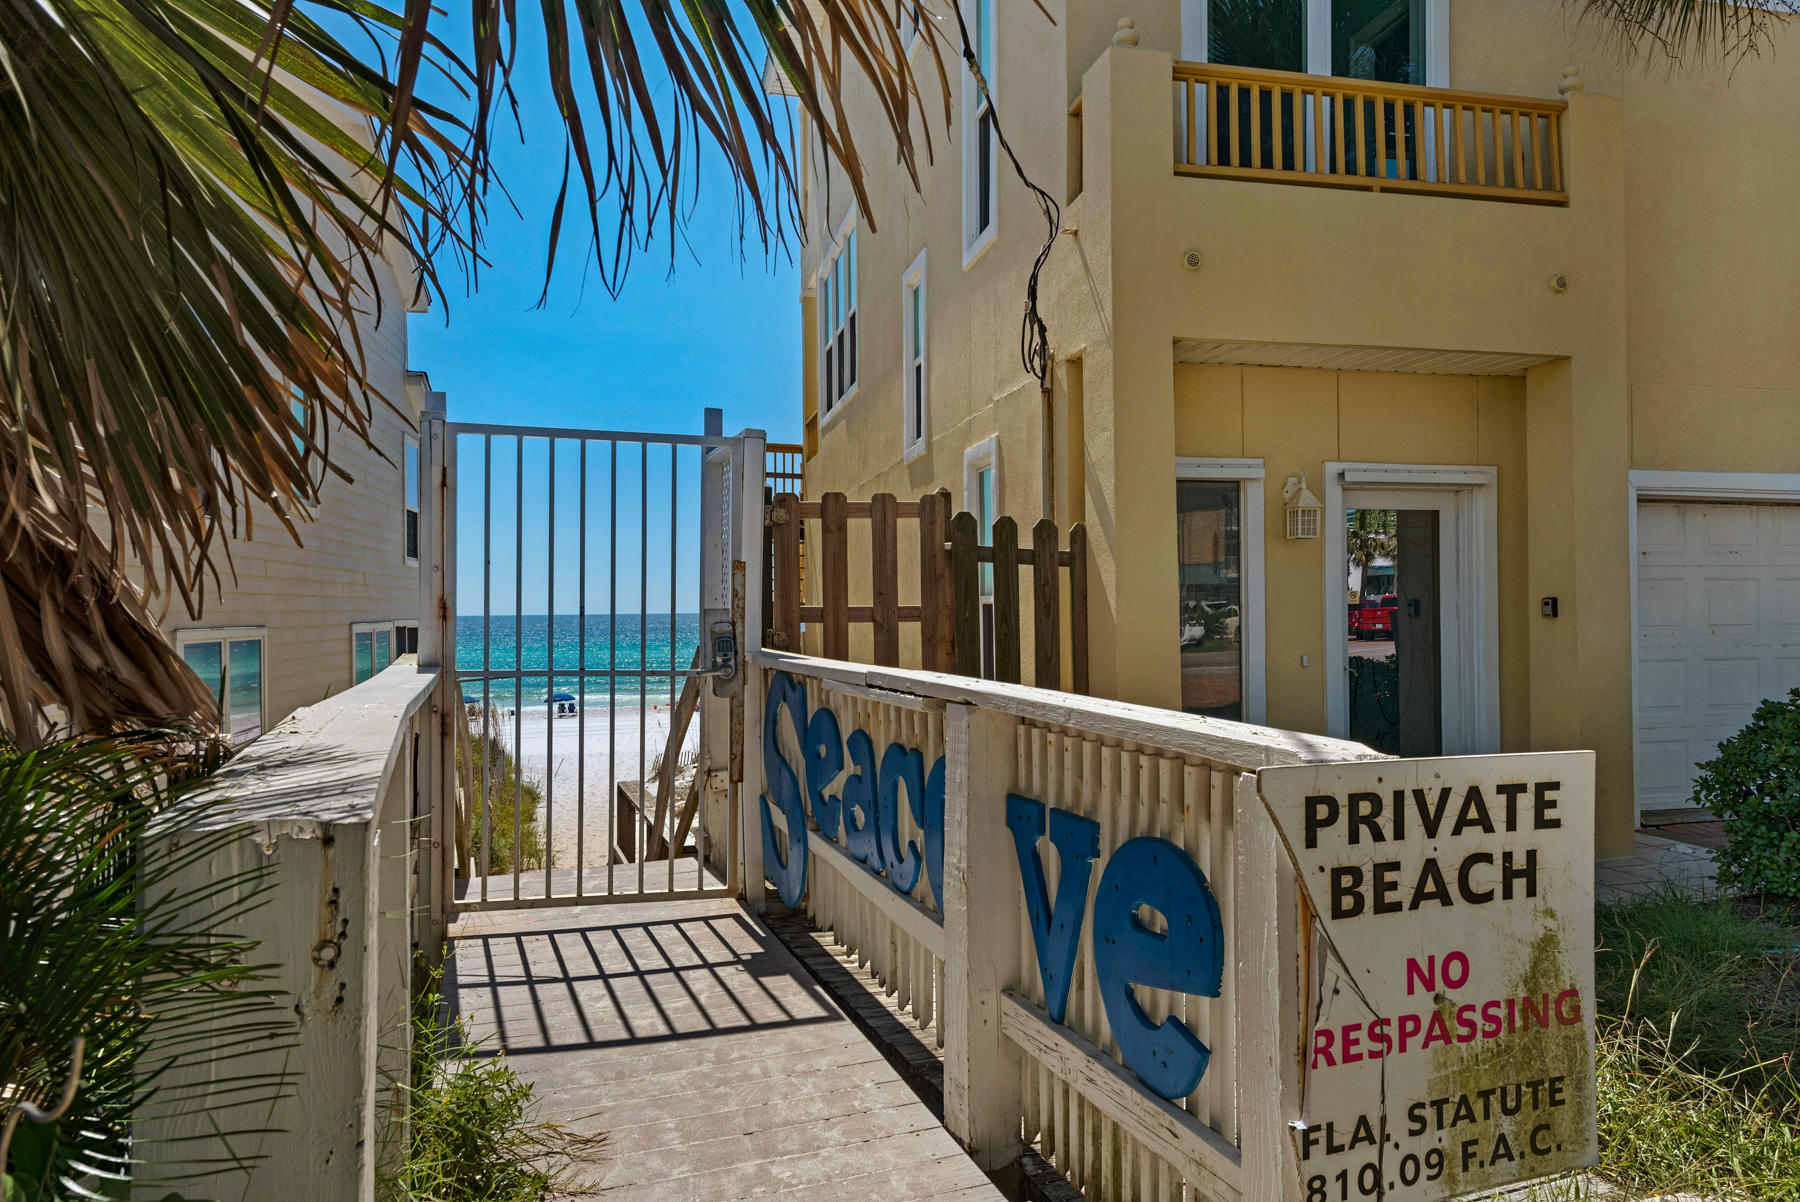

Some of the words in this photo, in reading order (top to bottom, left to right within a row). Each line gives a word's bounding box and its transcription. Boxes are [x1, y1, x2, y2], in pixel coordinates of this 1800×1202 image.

[1304, 781, 1561, 849] PRIVATE
[1330, 849, 1537, 920] BEACH
[1406, 951, 1470, 995] NO
[1302, 1114, 1391, 1161] FLA.
[1407, 1076, 1566, 1137] STATUTE
[1306, 1148, 1445, 1202] 810.09
[1461, 1123, 1562, 1173] F.A.C.
